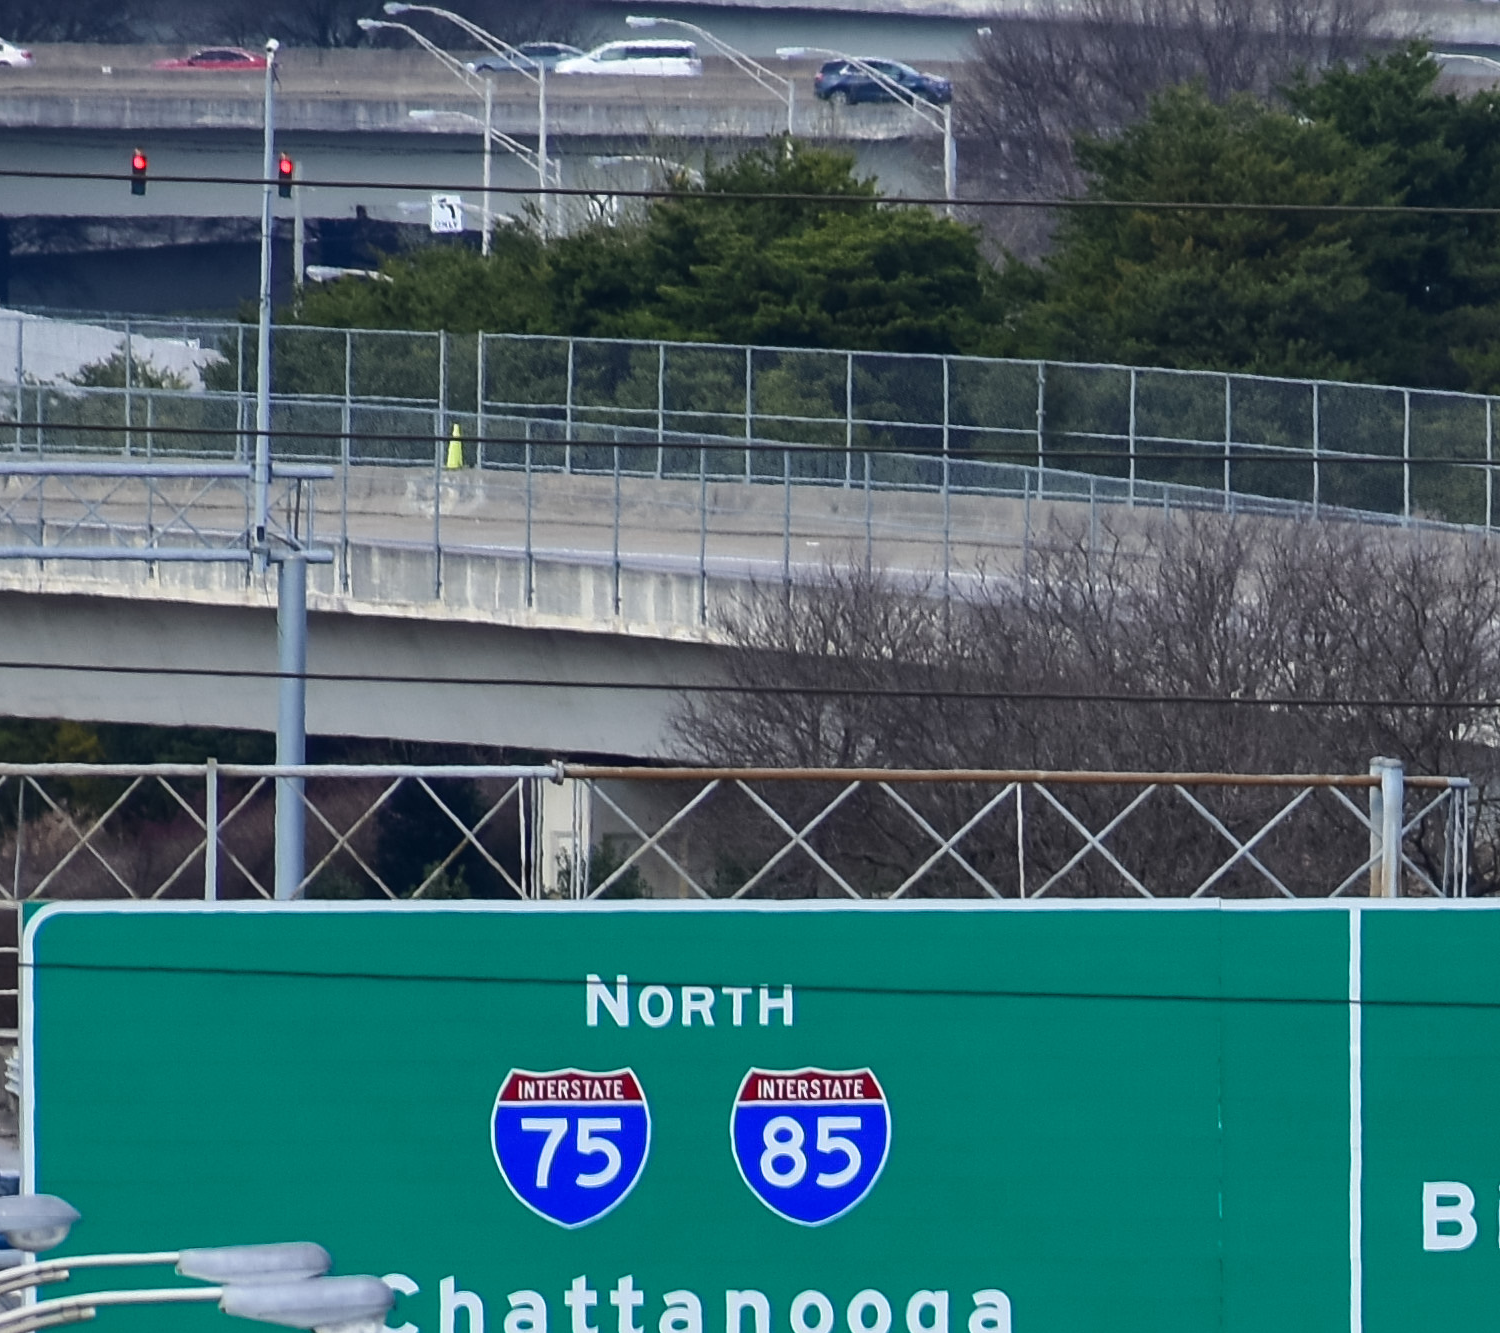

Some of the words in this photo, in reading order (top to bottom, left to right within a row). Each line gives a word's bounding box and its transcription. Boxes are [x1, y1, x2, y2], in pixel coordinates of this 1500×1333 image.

[585, 973, 797, 1028] NORTH
[516, 1077, 627, 1101] INTERSTATE
[755, 1077, 867, 1101] INTERSTATE
[519, 1116, 623, 1190] 75
[758, 1115, 865, 1190] 85
